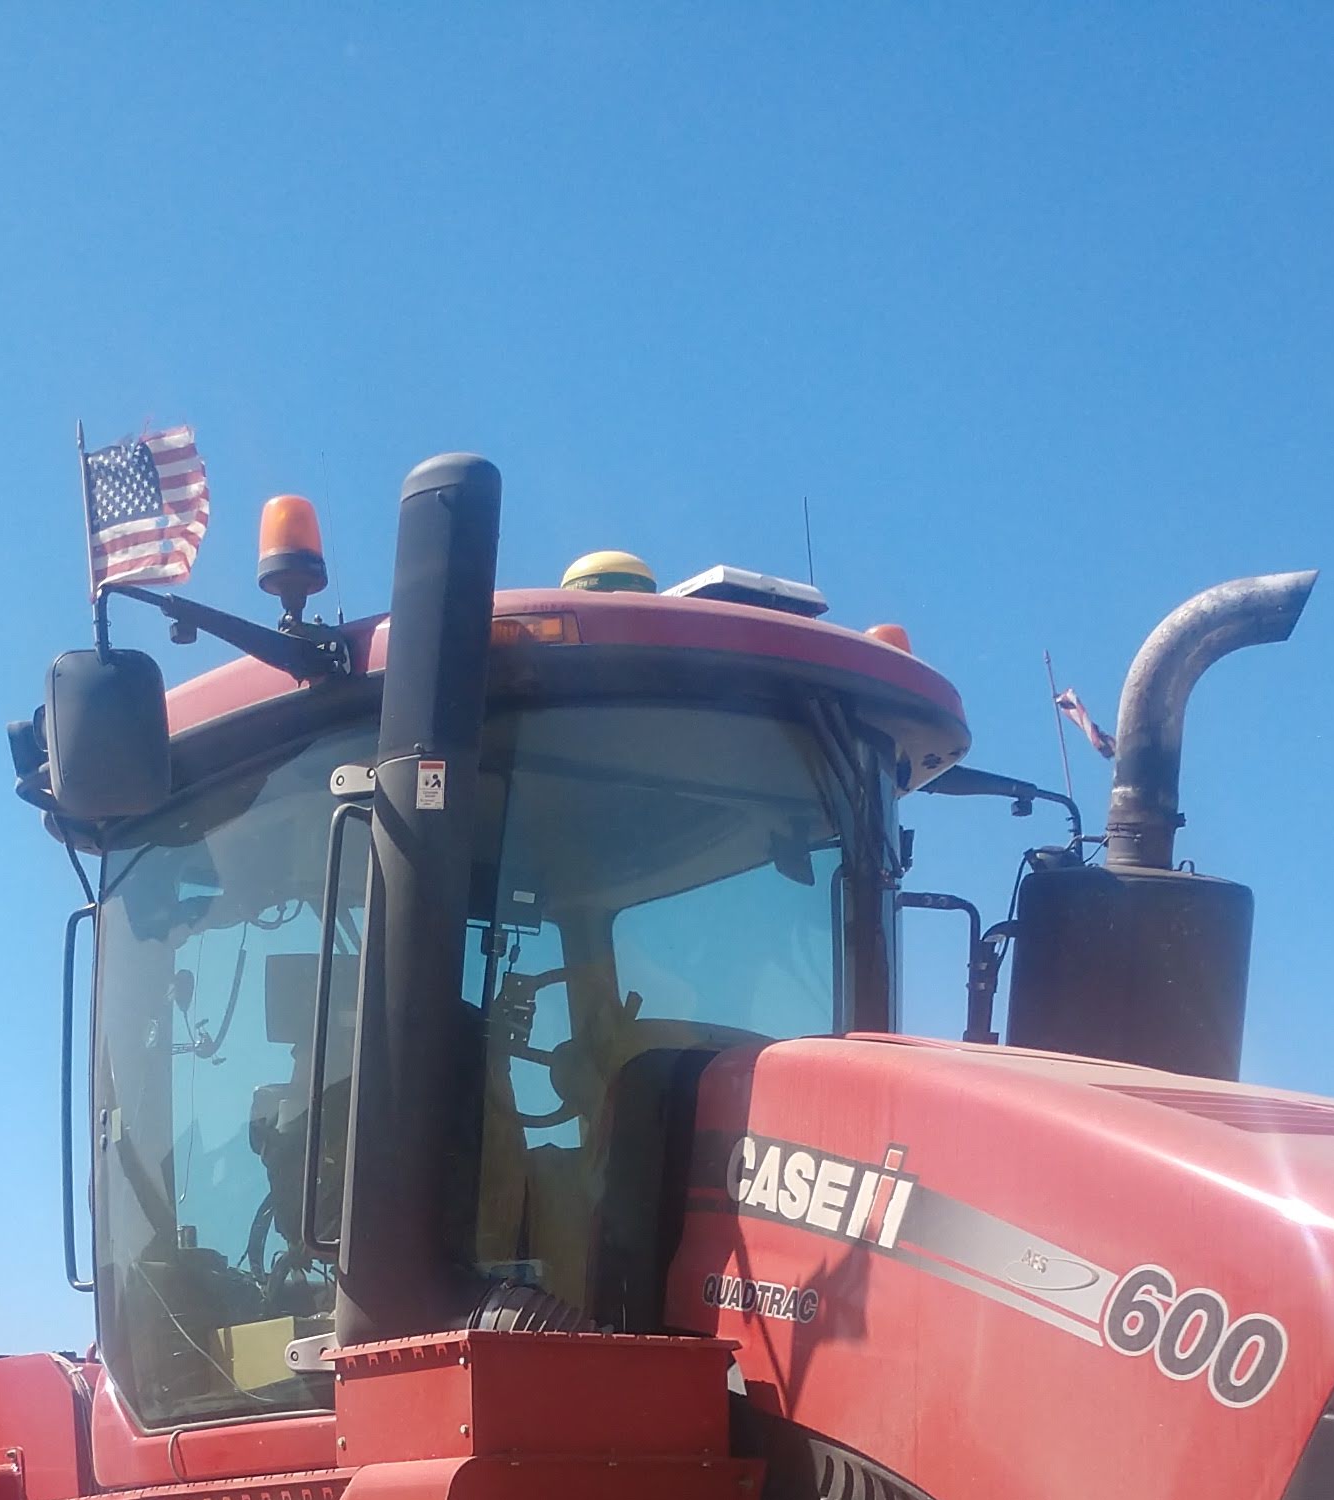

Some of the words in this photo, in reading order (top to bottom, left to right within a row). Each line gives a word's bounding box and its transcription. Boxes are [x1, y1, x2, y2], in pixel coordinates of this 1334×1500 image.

[727, 1136, 856, 1232] CASE
[703, 1273, 818, 1323] QUADTRAC
[1104, 1264, 1288, 1408] 600
